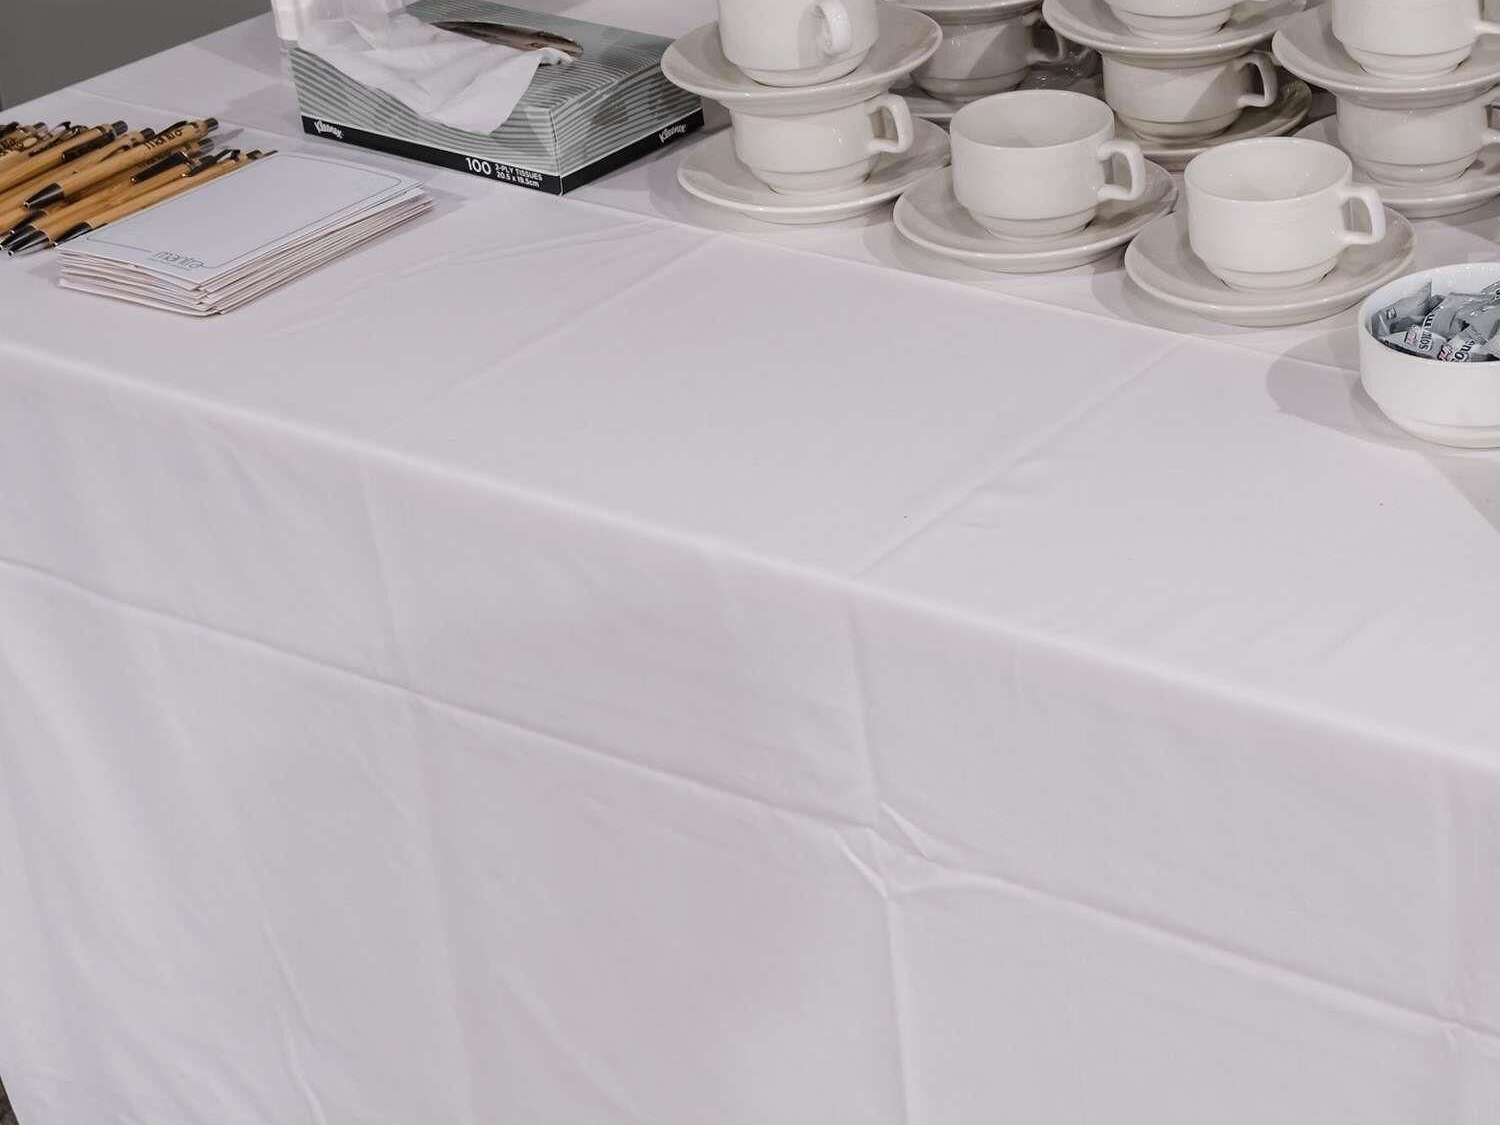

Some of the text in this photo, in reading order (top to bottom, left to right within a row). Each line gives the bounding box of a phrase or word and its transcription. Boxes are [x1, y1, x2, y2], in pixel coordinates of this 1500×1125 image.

[465, 157, 543, 181] 100 2-PLY TISSUES
[496, 171, 511, 181] 20.5
